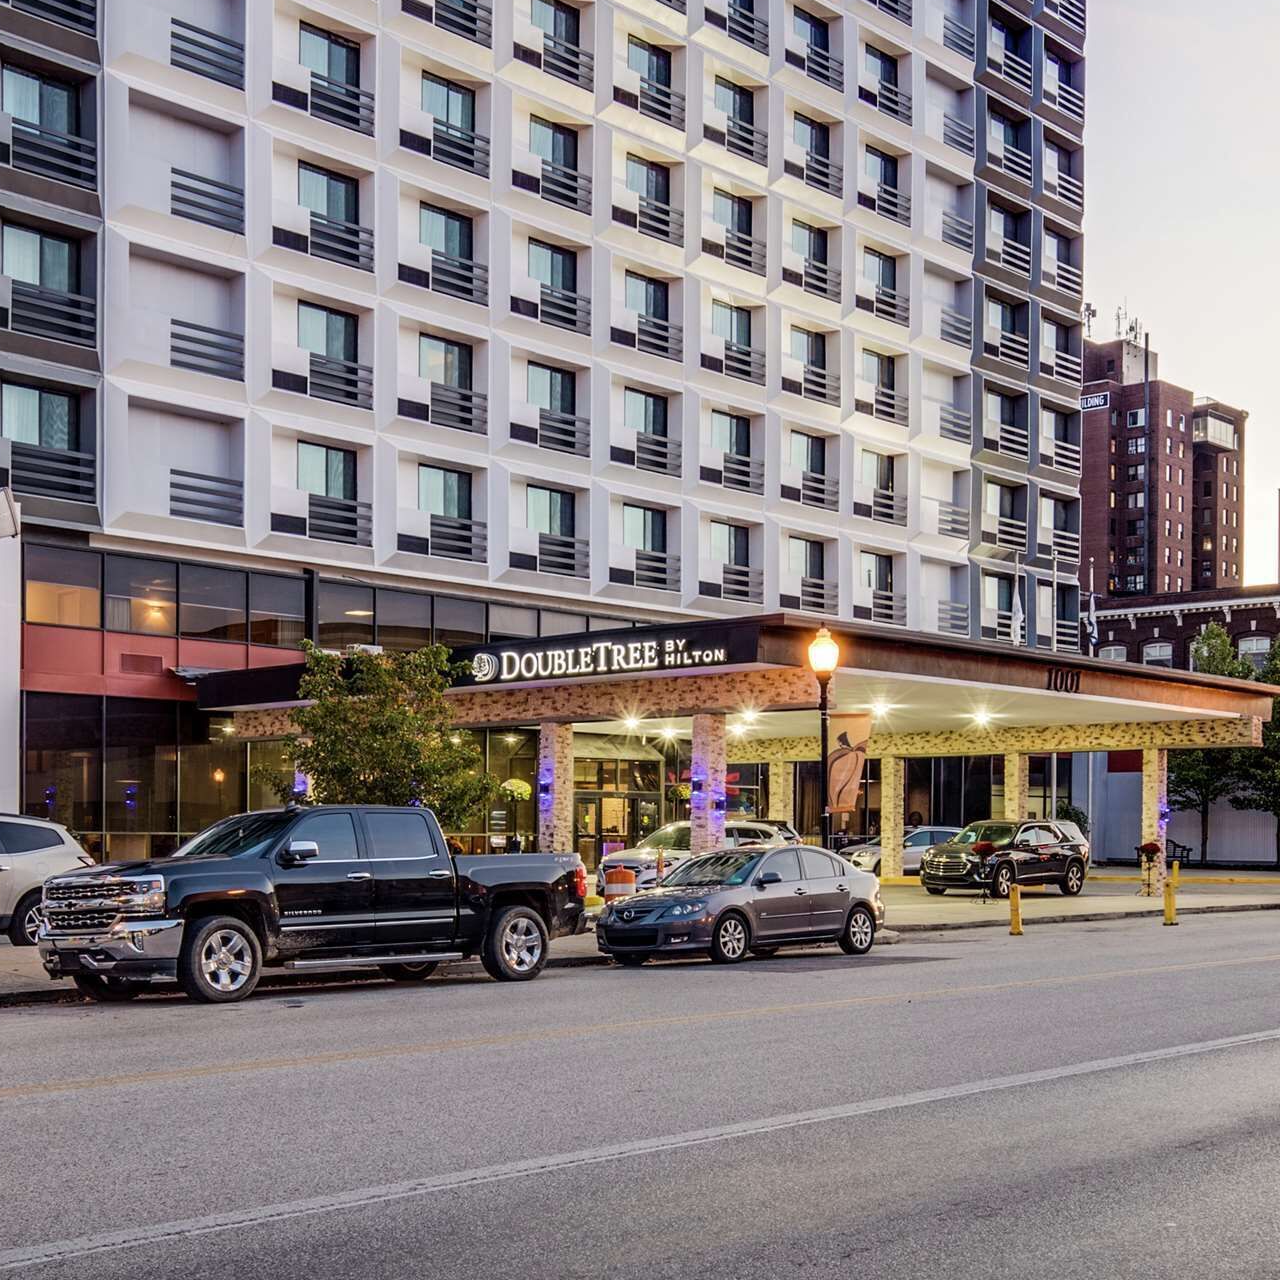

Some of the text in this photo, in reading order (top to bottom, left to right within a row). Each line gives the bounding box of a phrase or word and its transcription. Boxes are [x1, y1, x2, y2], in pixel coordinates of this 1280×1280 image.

[665, 639, 686, 651] BY
[665, 649, 724, 665] HILTON
[1046, 668, 1082, 693] 1001
